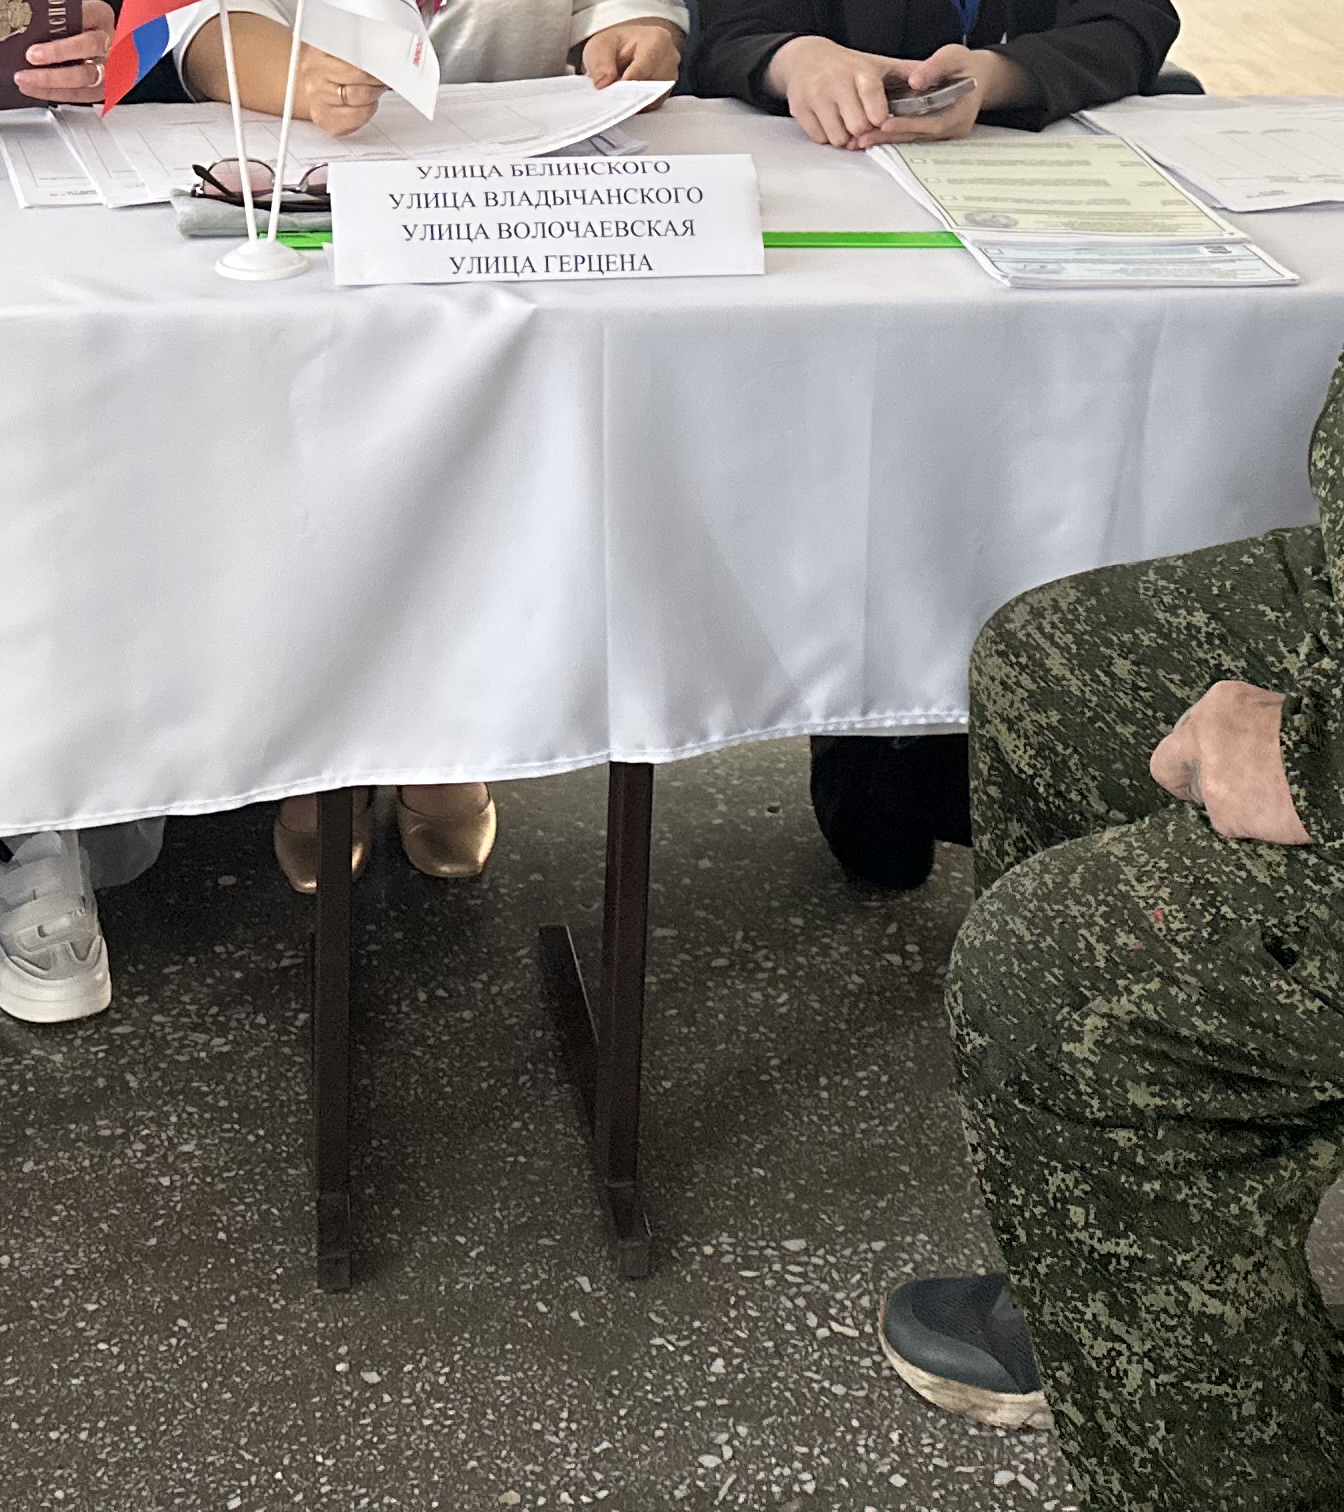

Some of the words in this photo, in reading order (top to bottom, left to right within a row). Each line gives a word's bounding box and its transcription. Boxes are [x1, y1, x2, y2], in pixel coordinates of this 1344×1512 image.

[416, 164, 505, 181] УЛИЦА
[510, 159, 671, 179] БЕЛИНСКОГО
[388, 191, 476, 212] УЛИЦА
[483, 186, 704, 211] ВЛАДЫЧАНСКОГО
[401, 223, 490, 244] УЛИЦА
[497, 218, 697, 241] ВОЛОЧАЕВСКАЯ
[449, 255, 537, 276] УЛИЦА
[544, 253, 654, 275] ГЕРЦЕНА
